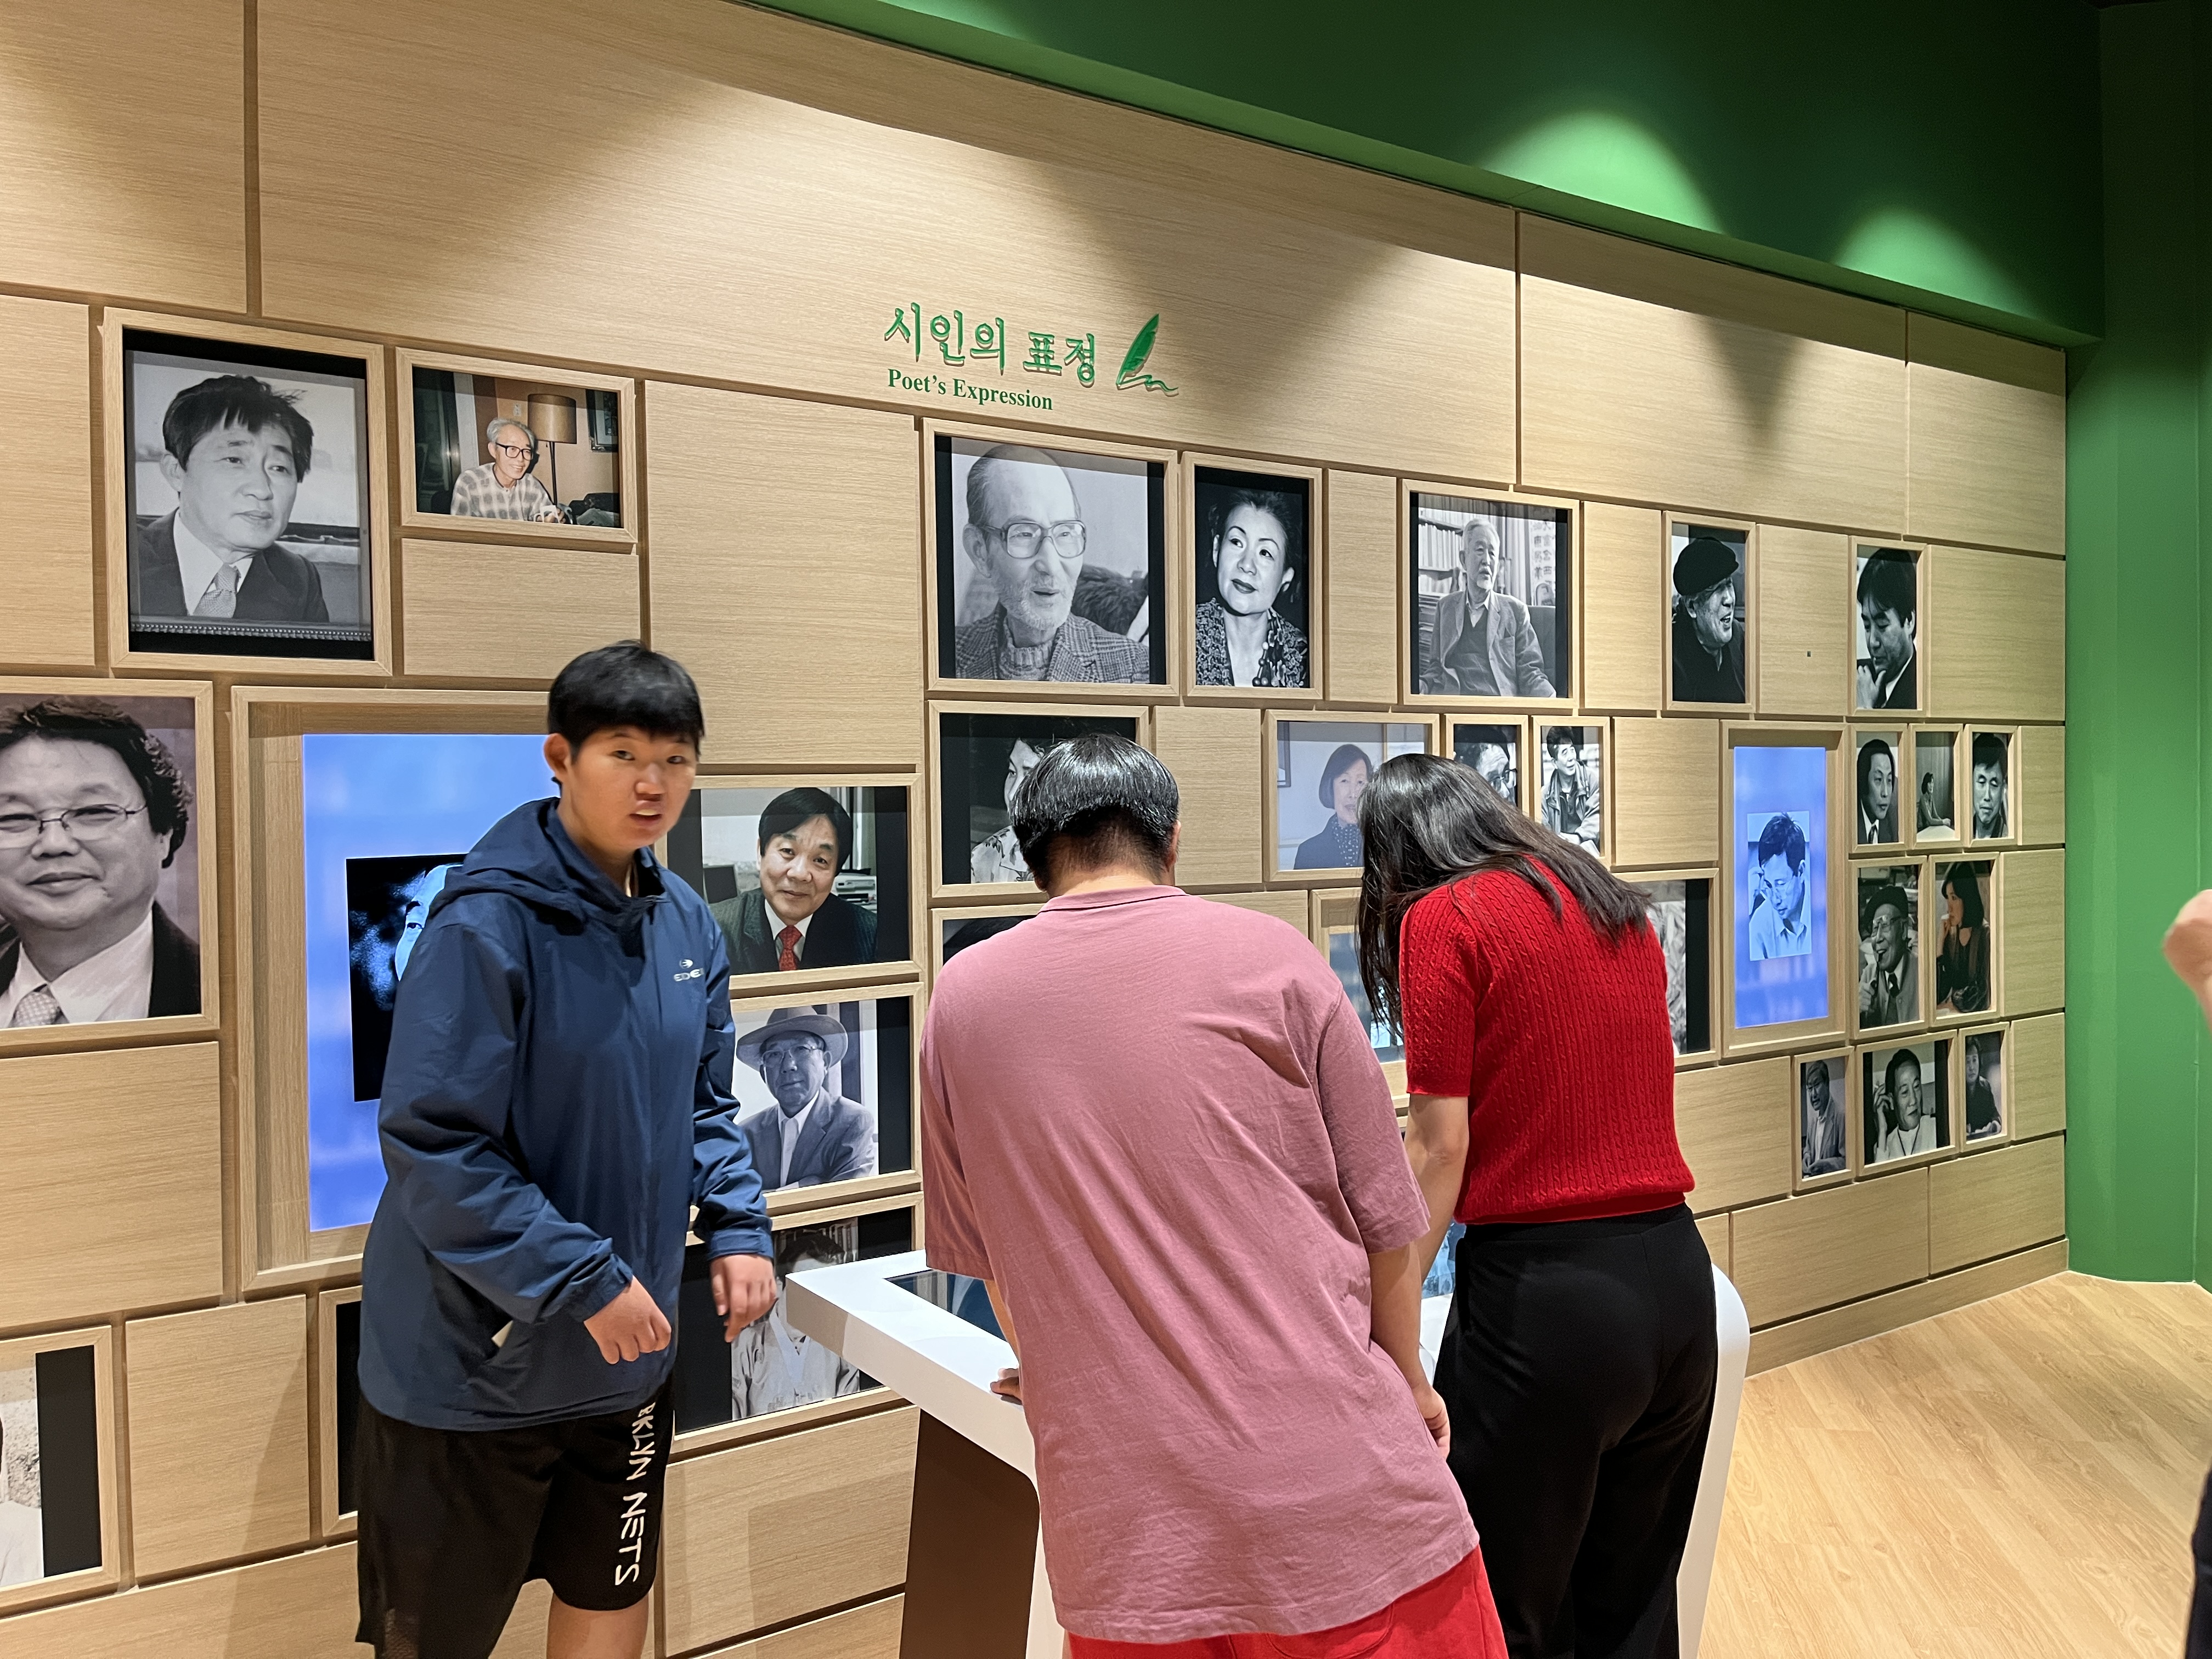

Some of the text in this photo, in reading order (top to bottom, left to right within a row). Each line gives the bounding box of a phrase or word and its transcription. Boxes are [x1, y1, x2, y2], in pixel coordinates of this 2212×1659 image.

[884, 302, 1096, 385] 시인의 표정
[888, 368, 1053, 410] Poet’s Expression
[614, 1492, 648, 1585] NETS
